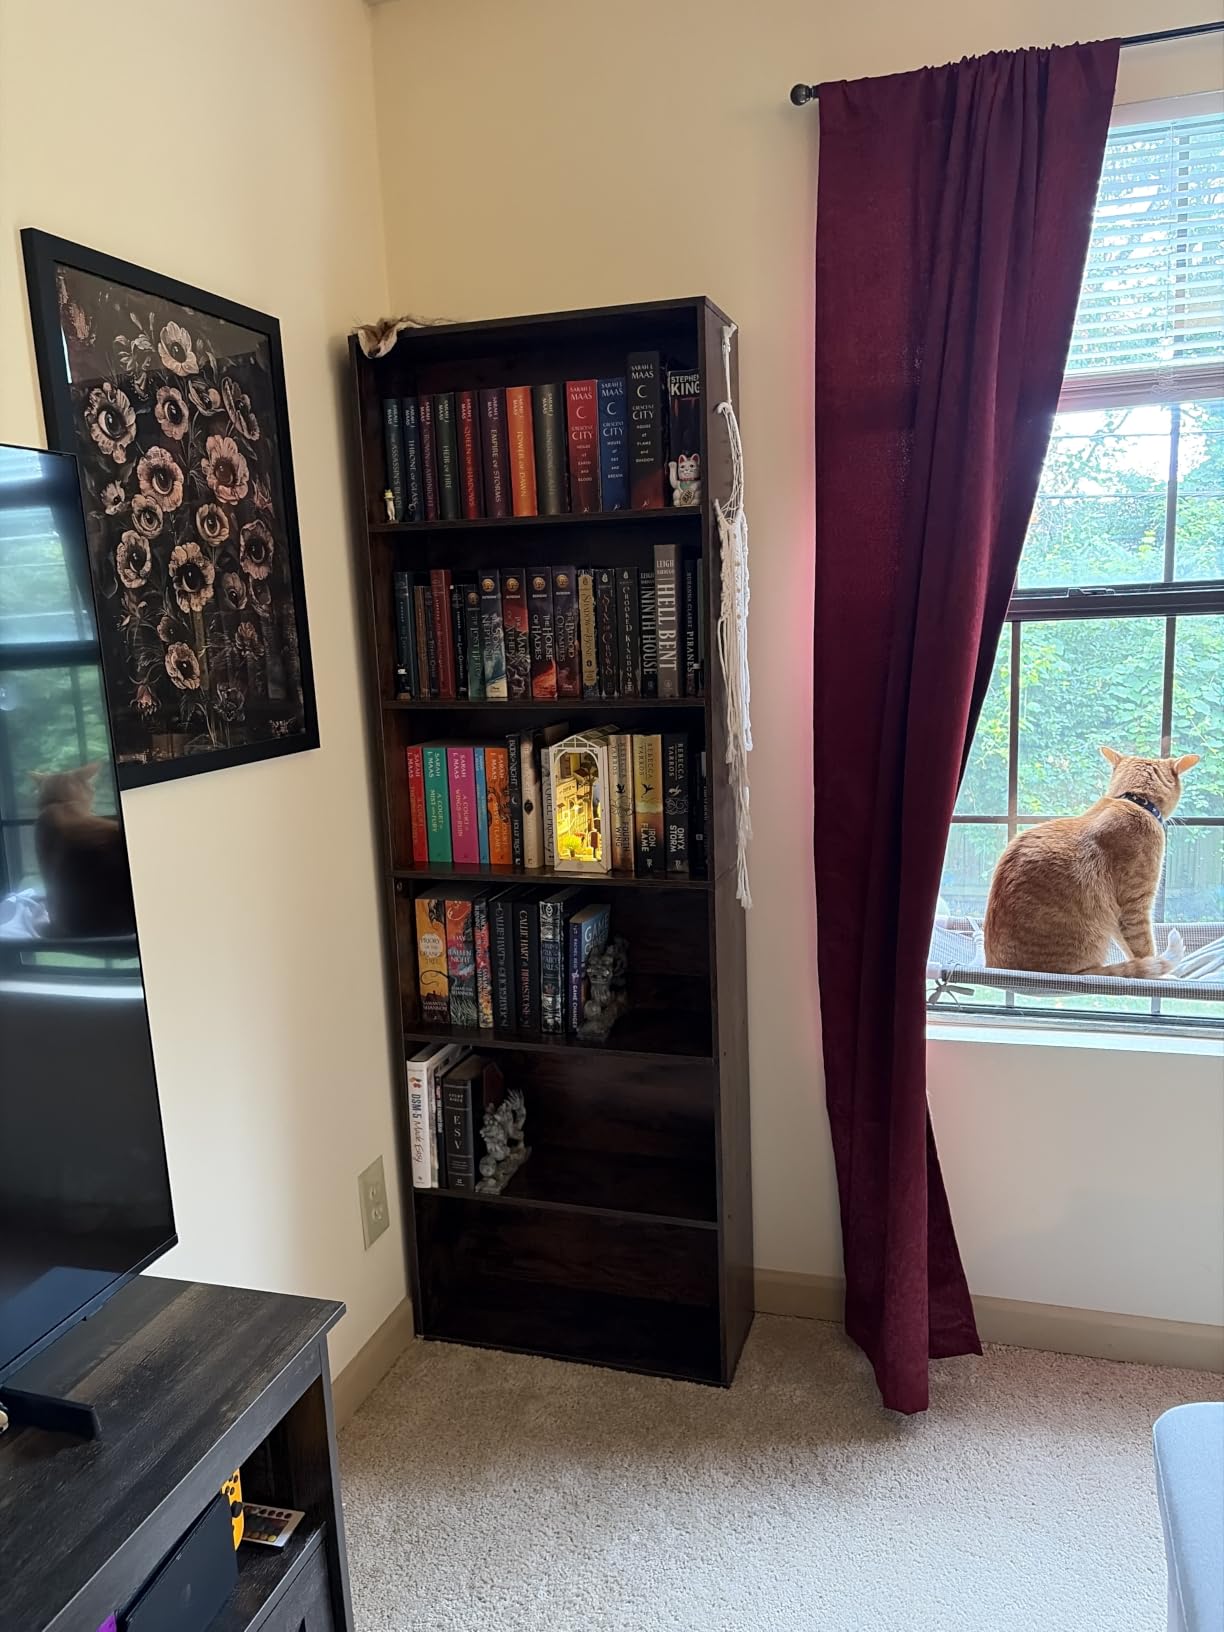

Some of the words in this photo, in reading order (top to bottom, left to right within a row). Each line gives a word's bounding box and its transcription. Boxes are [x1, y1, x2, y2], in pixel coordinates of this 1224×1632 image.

[632, 410, 654, 420] CITY
[516, 431, 524, 459] TOWER
[572, 431, 592, 440] CITY
[603, 428, 624, 436] CITY
[408, 440, 416, 471] THRONE
[442, 446, 450, 464] HEIR
[464, 426, 472, 454] QUEEN
[468, 468, 476, 506] SHADOWS
[493, 470, 501, 503] STORMS
[583, 594, 592, 626] SHADOW
[622, 587, 632, 632] CROOKED
[641, 590, 656, 630] NINTH
[657, 583, 676, 625] HELL
[470, 627, 480, 649] LOST
[505, 624, 515, 664] ATHENA
[517, 629, 526, 660] MARK
[532, 626, 542, 660] HADES
[542, 627, 553, 661] HOUSE
[556, 616, 565, 662] OLYMPUS
[565, 623, 575, 658] BLOOD
[584, 634, 592, 657] BONE
[658, 630, 676, 671] BENT
[643, 635, 657, 675] HOUSE
[510, 763, 518, 785] NIGHT
[622, 822, 630, 852] FOURTH
[496, 909, 504, 936] CALLIE
[519, 910, 528, 937] CALLIE
[520, 940, 528, 961] HART
[521, 969, 530, 1016] BRIMSTONE
[414, 1121, 423, 1141] Made
[414, 1144, 423, 1163] Easy
